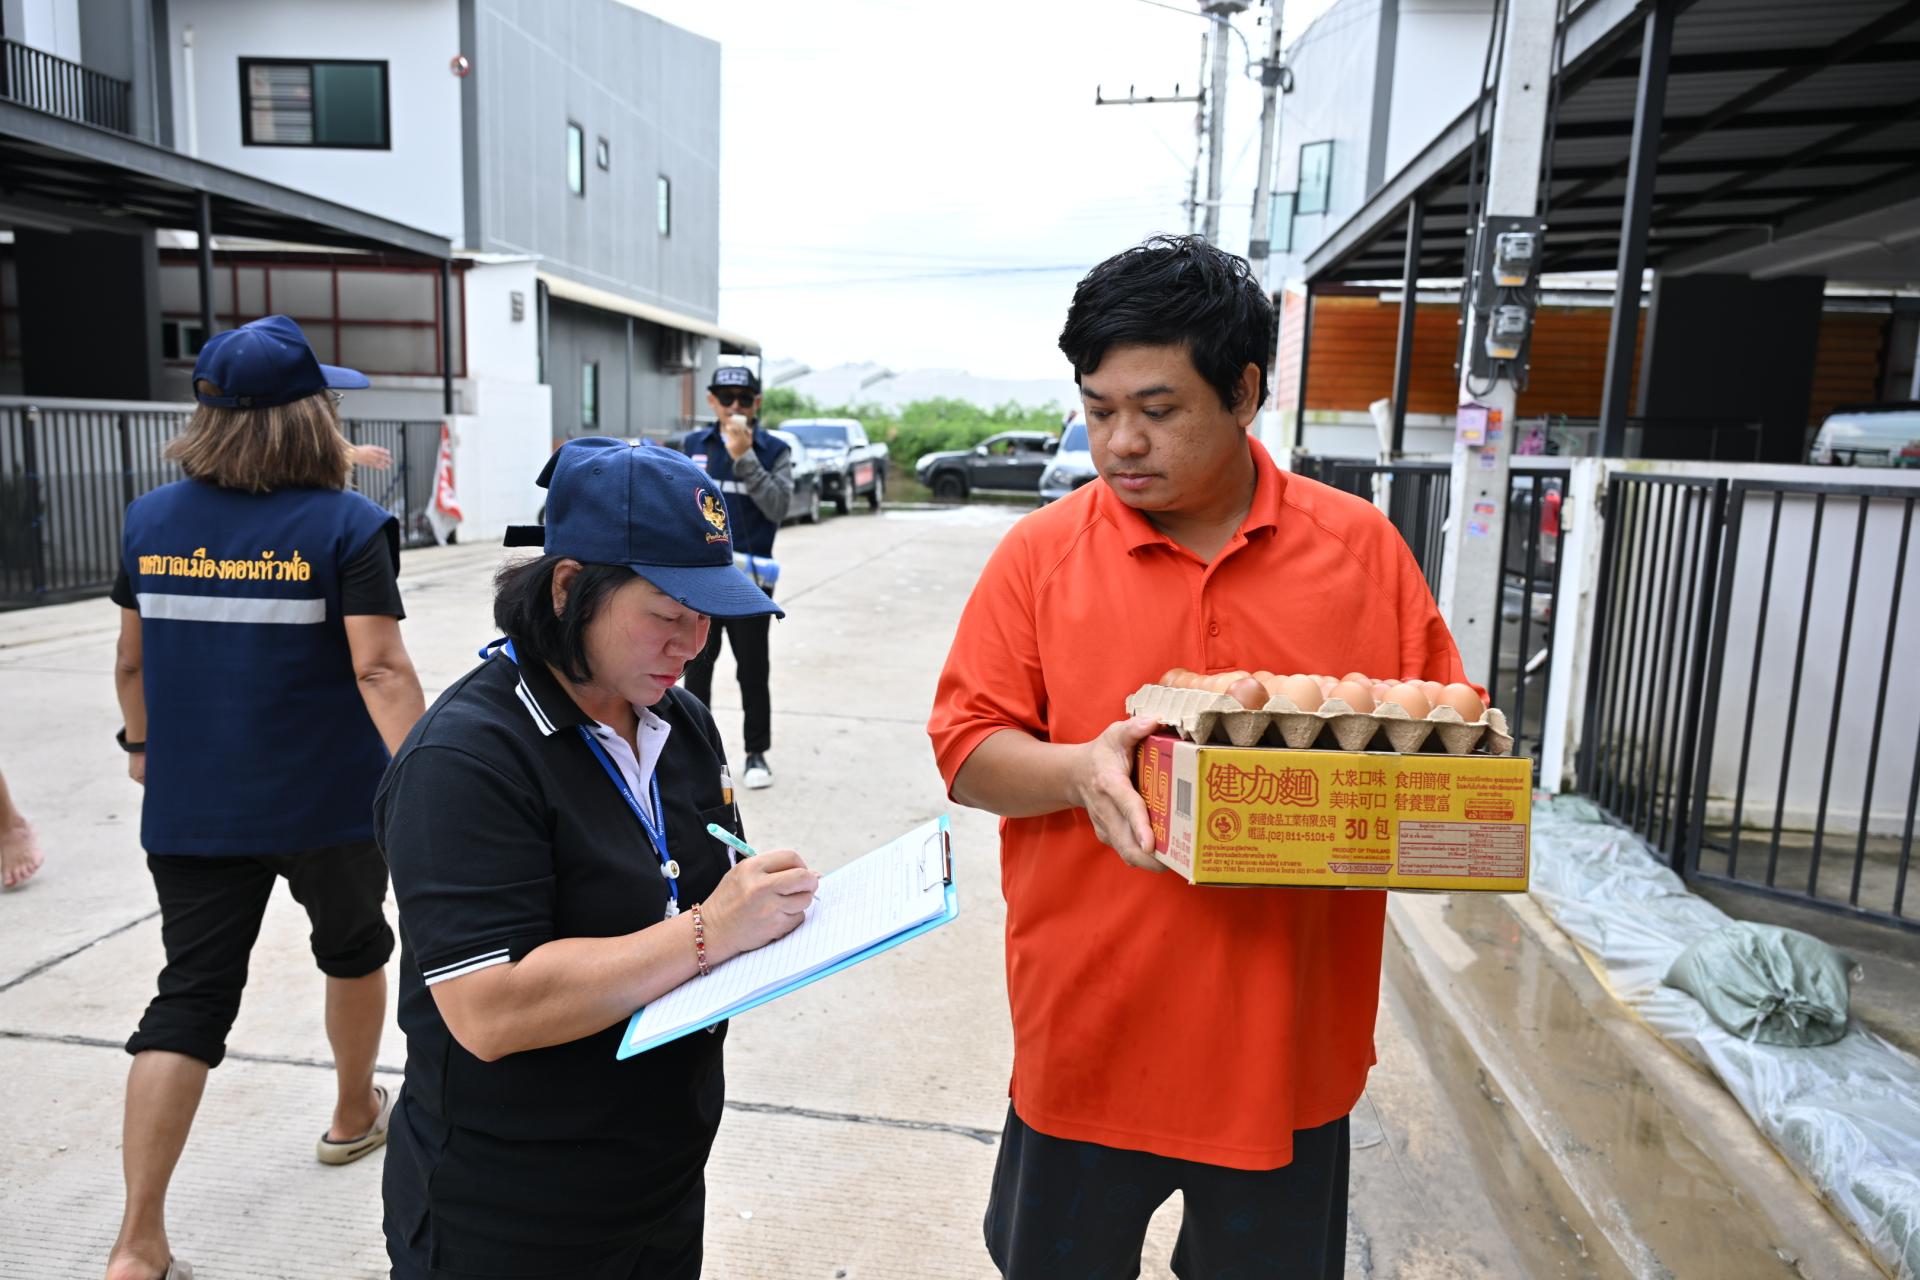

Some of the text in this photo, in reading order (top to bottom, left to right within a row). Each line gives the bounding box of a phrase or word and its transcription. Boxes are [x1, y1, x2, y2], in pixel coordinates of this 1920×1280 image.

[1206, 763, 1319, 807] 健力麵
[1329, 791, 1387, 810] 美味可口
[1344, 816, 1391, 840] 30 包
